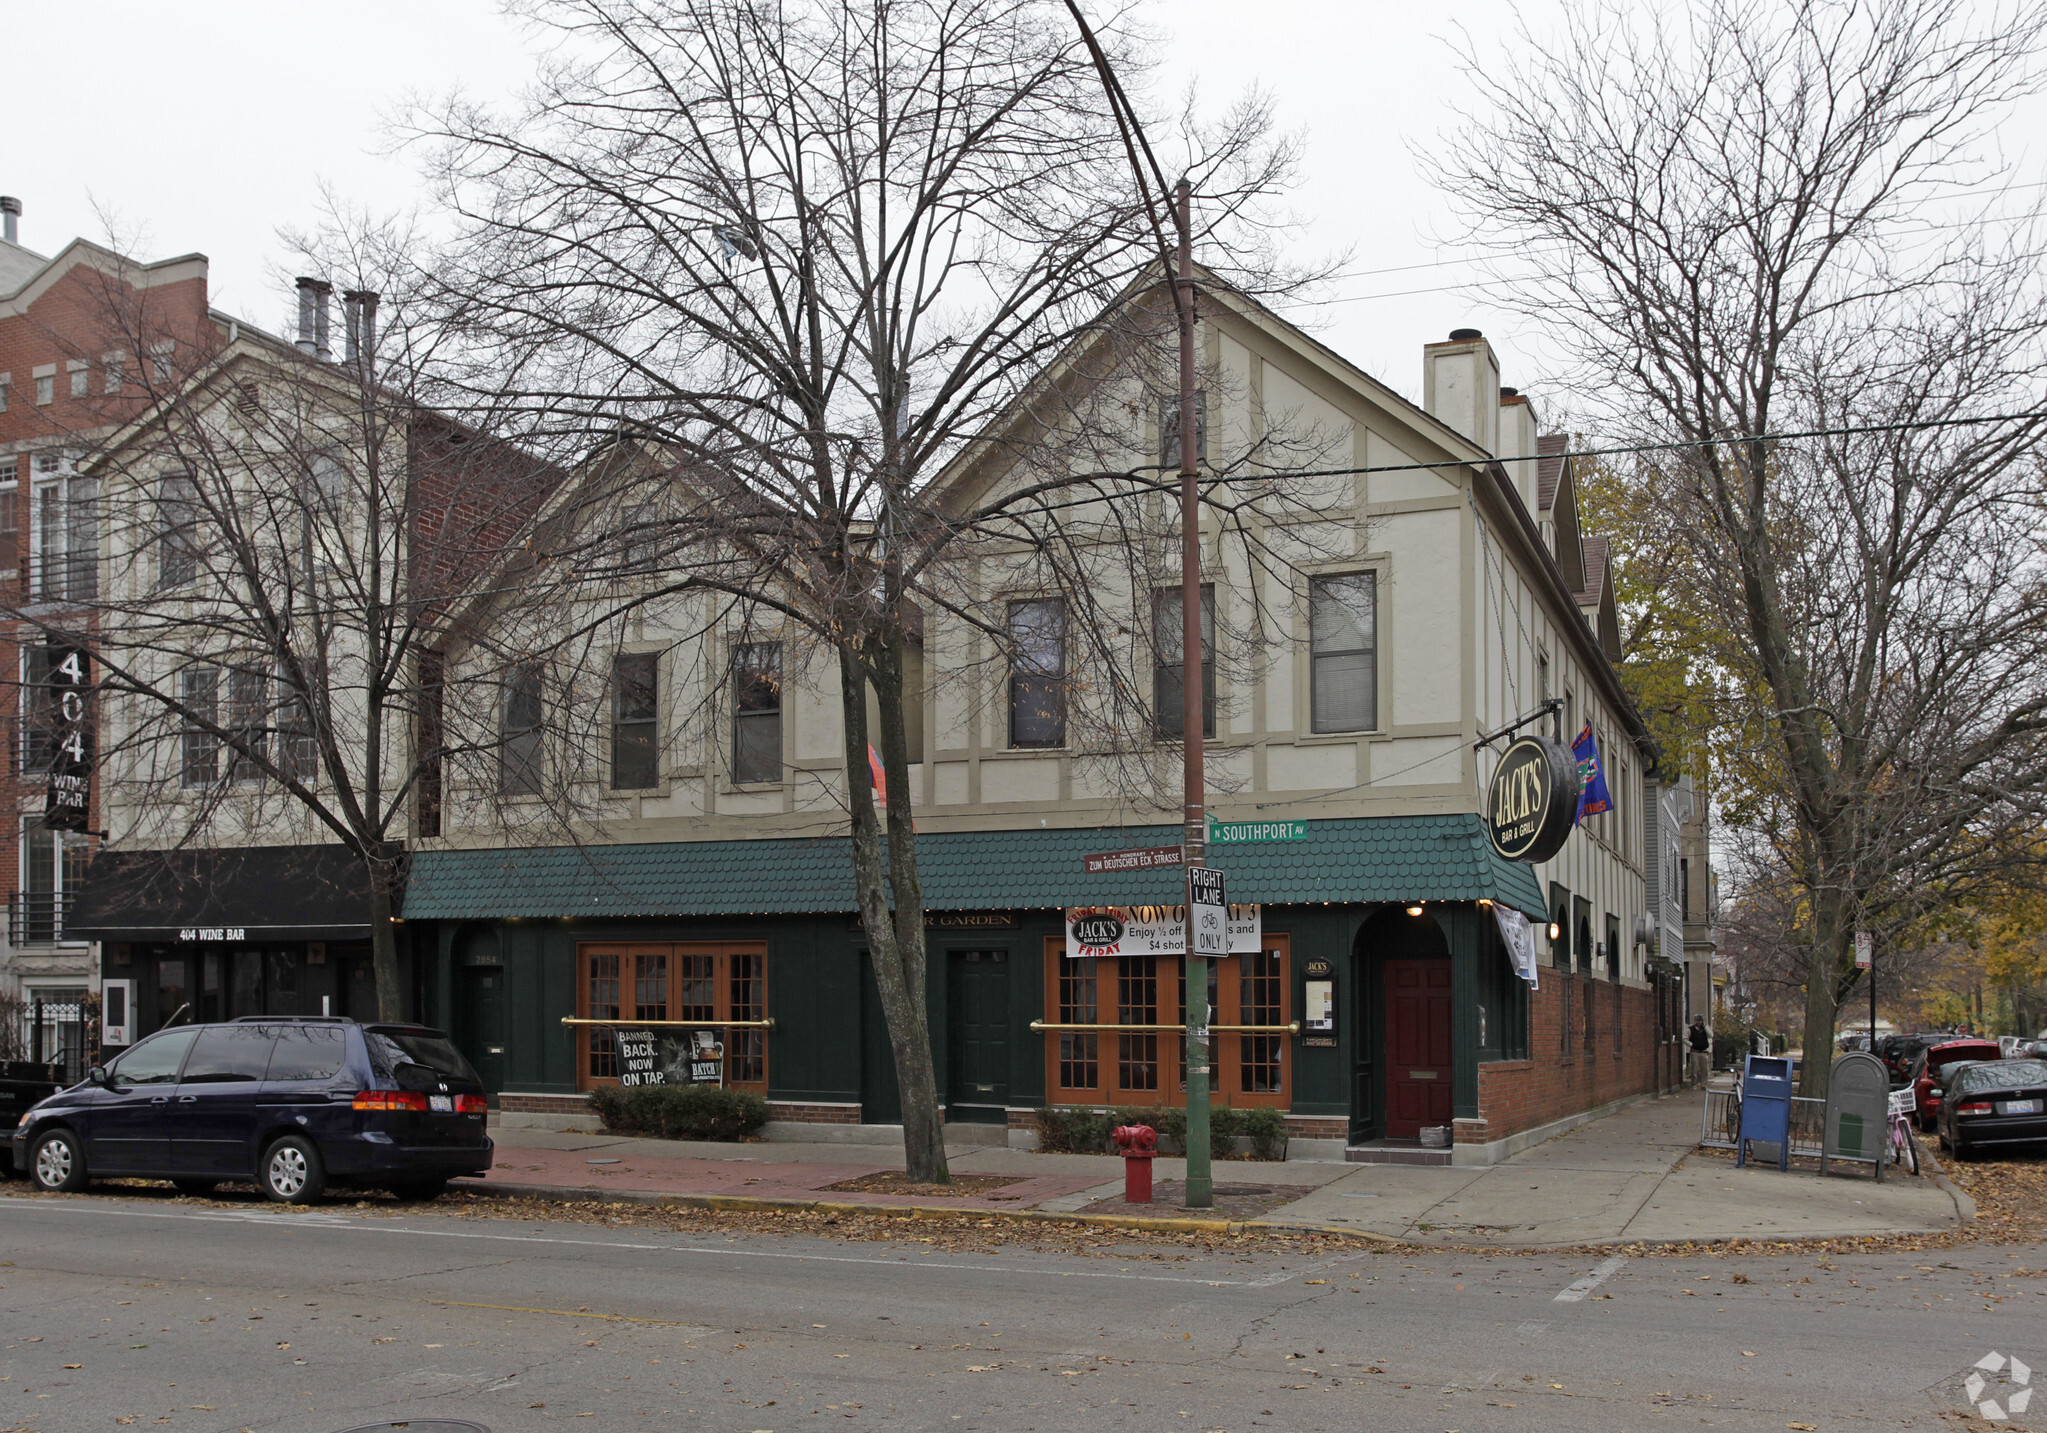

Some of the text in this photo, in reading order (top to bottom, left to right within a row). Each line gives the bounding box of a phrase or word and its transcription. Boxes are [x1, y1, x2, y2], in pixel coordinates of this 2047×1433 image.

[59, 652, 84, 763] 404
[57, 791, 84, 807] BAR
[1496, 757, 1542, 828] JACK'S
[1215, 823, 1304, 841] N SOUTHPORT AV
[1501, 821, 1535, 844] BAR & GRILL
[1089, 852, 1180, 871] ZUM DEUTSCHEN ECK STRASSE
[1192, 869, 1221, 888] RIGHT
[1195, 887, 1221, 905] LANE
[940, 915, 1011, 926] GARDEN
[1067, 906, 1097, 925] FRIDAY
[1128, 905, 1168, 924] NOW
[1173, 905, 1185, 923] O
[1247, 904, 1256, 921] 3
[180, 928, 245, 941] 404 WINE BAR
[1078, 920, 1117, 938] JACK'S
[1129, 927, 1155, 939] Enjoy
[1169, 926, 1182, 936] off
[1236, 924, 1254, 934] and
[1078, 942, 1120, 956] FRIDAY
[1149, 940, 1160, 951] $4
[1200, 933, 1221, 950] ONLY
[1308, 962, 1327, 971] JACK'S
[619, 1031, 658, 1042] BANNED.
[622, 1043, 659, 1058] BACK.
[629, 1059, 653, 1071] NOW
[691, 1062, 716, 1076] BATCH
[622, 1071, 666, 1087] ON TAP.
